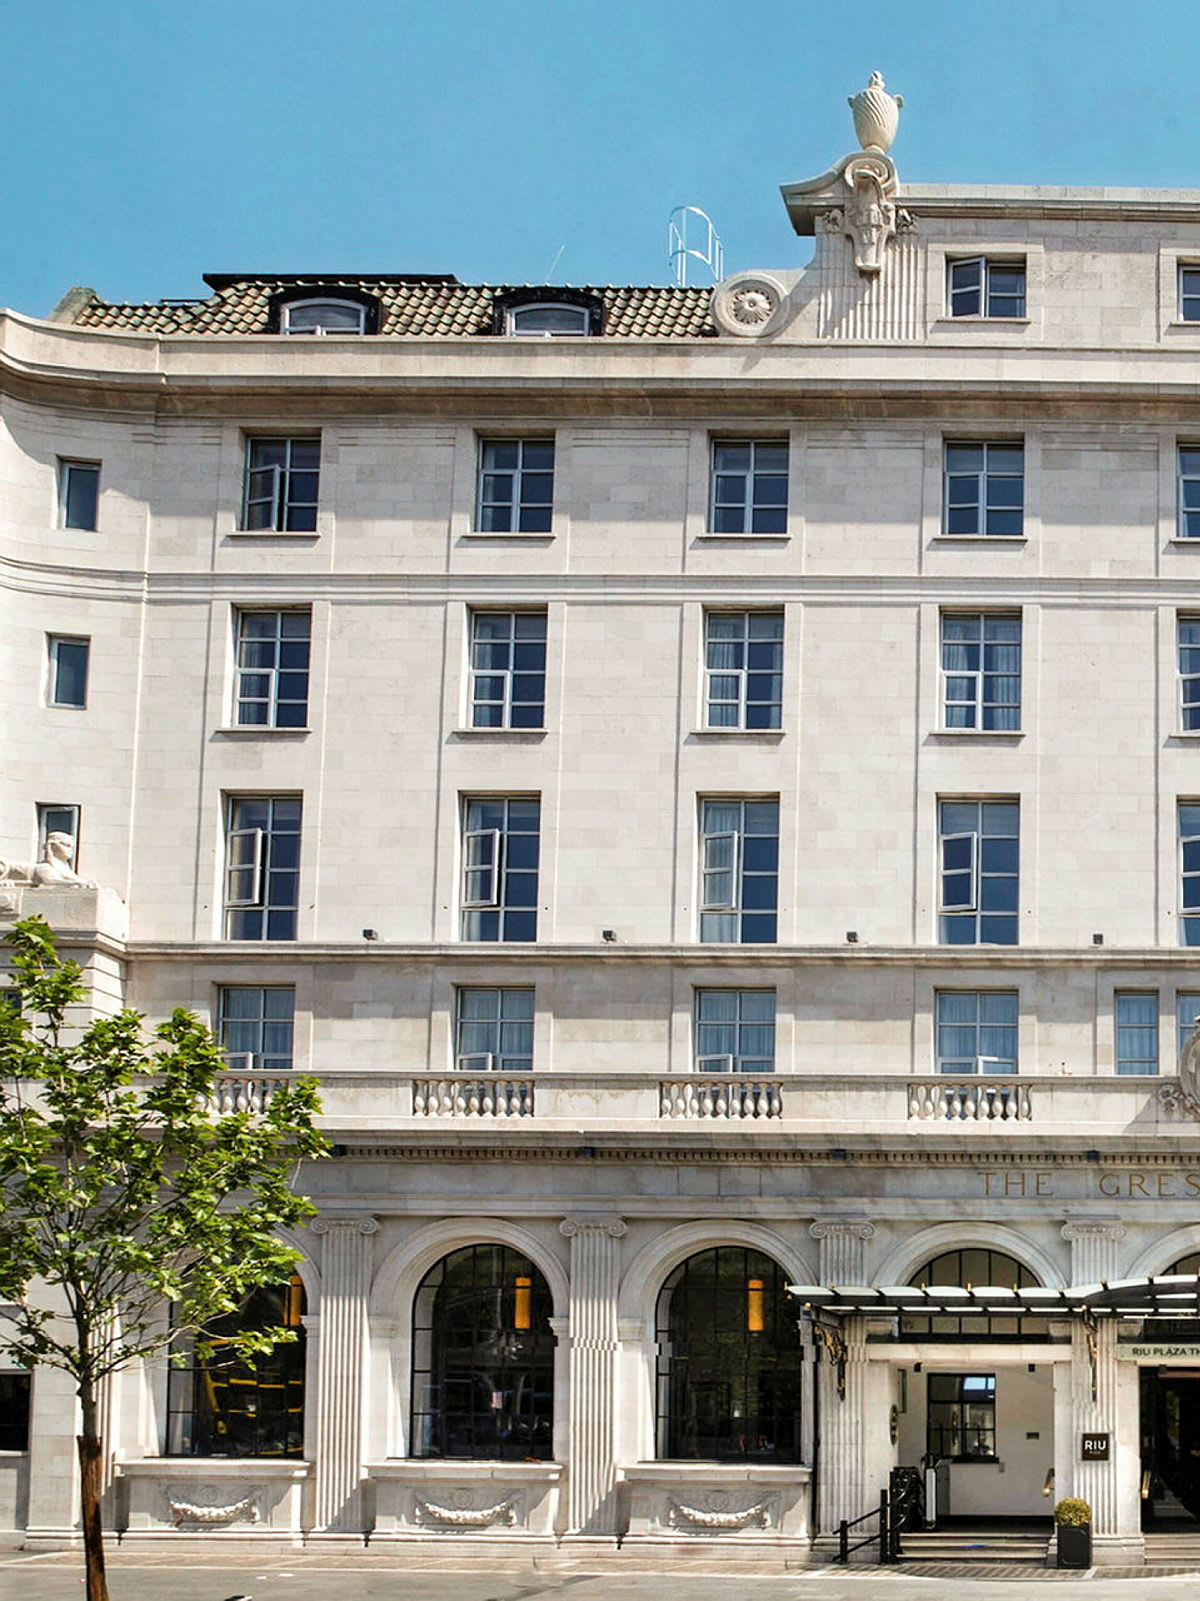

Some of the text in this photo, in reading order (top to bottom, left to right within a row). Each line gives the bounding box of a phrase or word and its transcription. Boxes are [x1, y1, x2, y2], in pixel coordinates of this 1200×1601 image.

[979, 1172, 1055, 1196] THE
[1132, 1347, 1150, 1356] RIU
[1153, 1347, 1187, 1356] PLAZA
[1085, 1440, 1106, 1450] RIU
